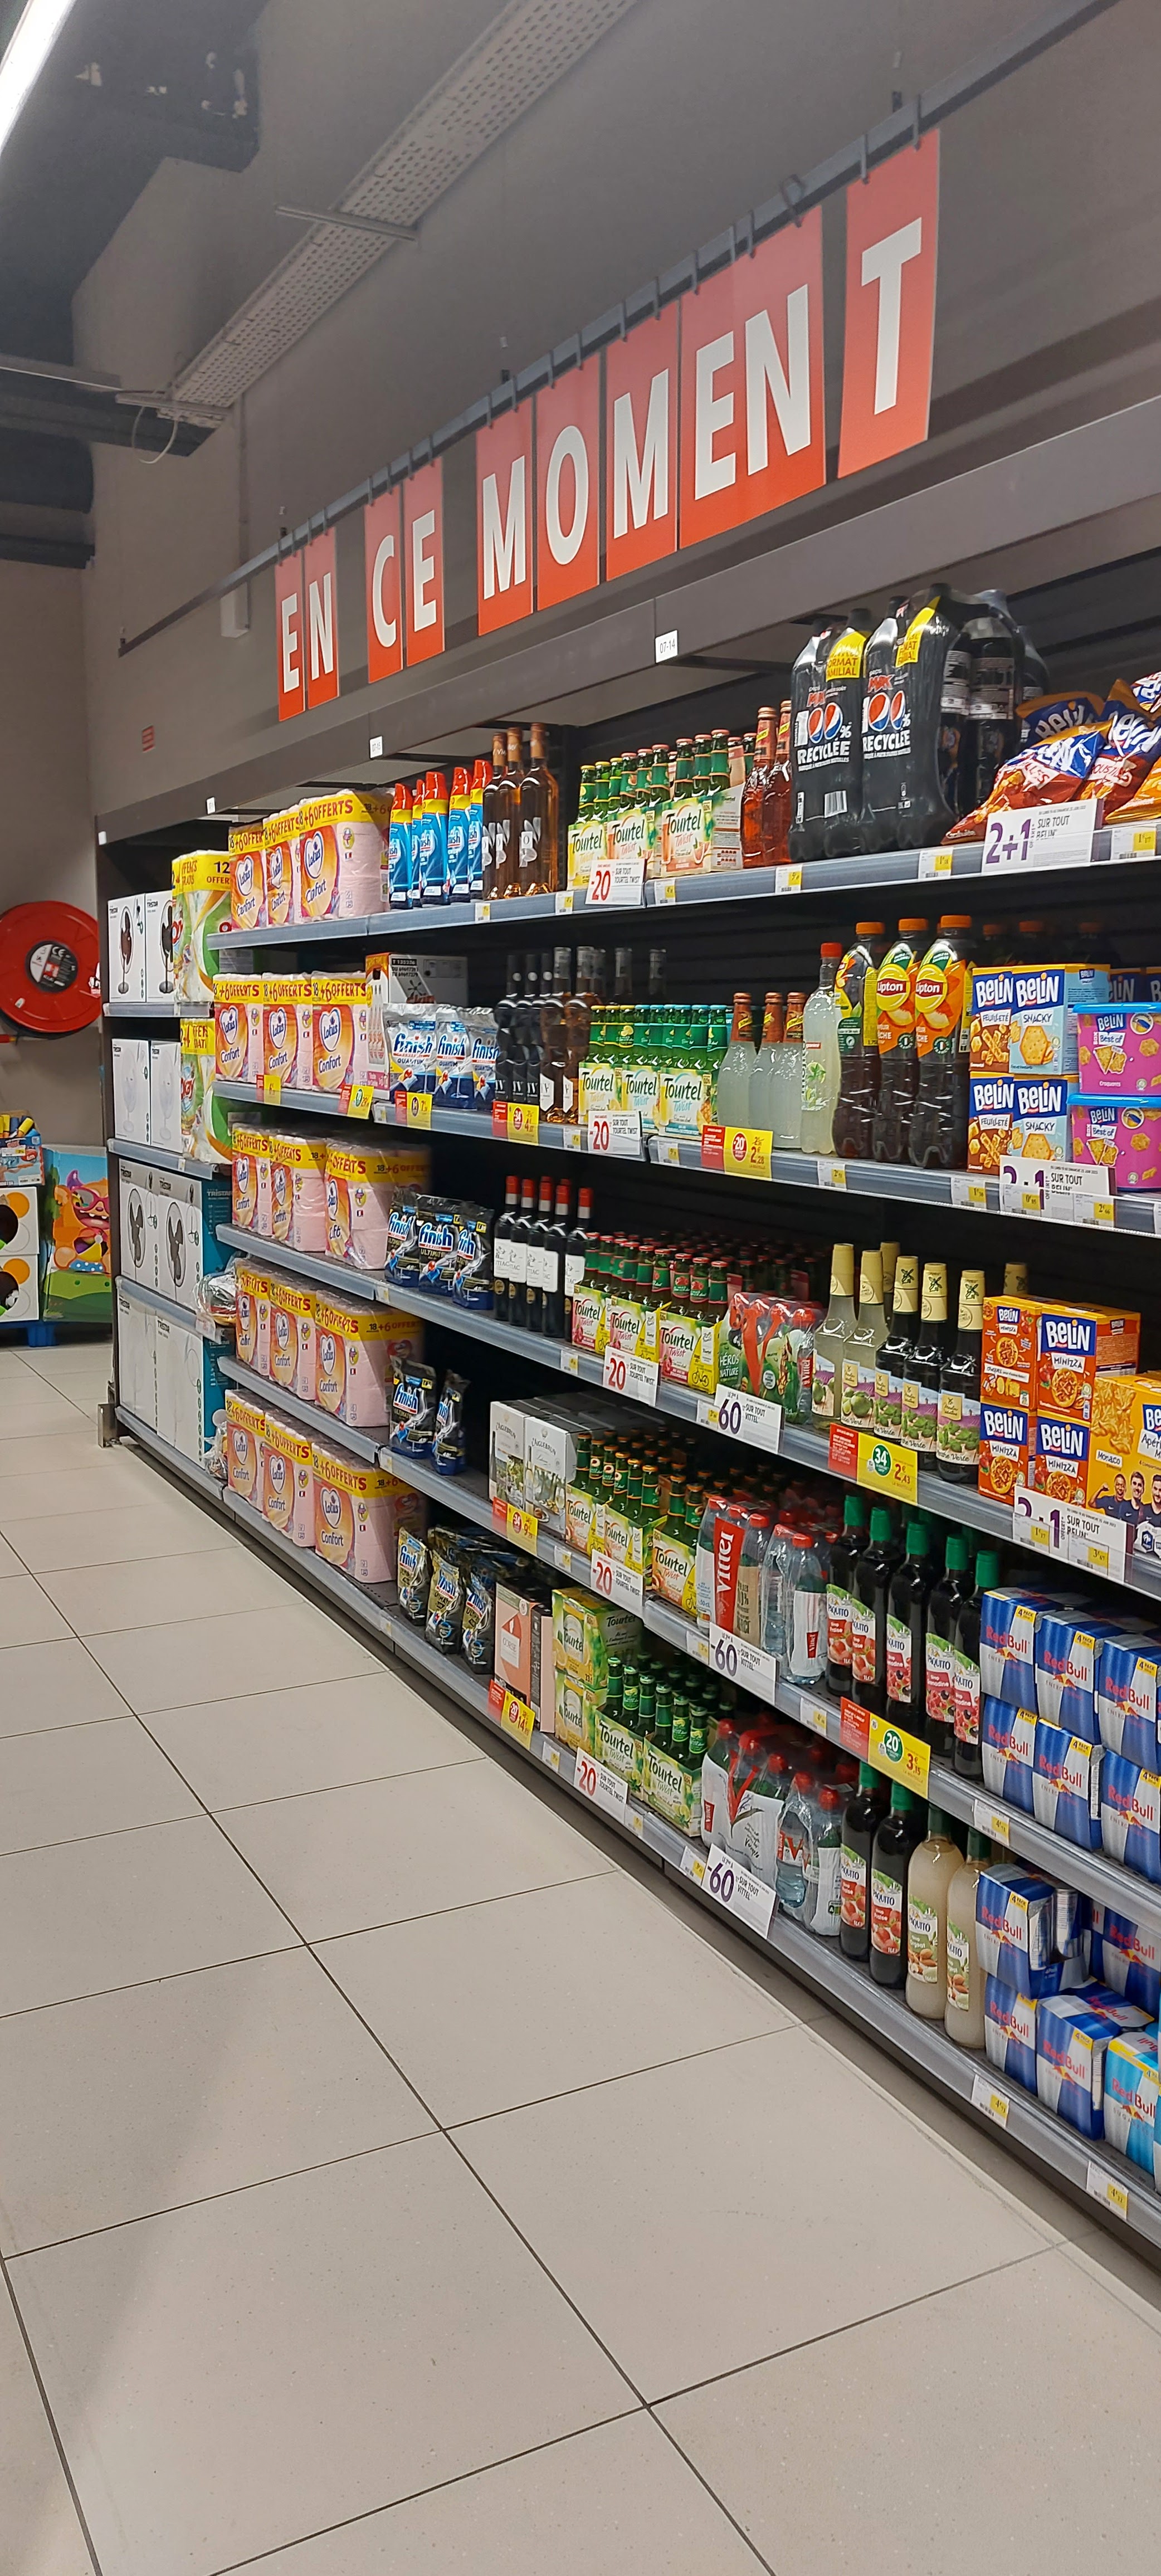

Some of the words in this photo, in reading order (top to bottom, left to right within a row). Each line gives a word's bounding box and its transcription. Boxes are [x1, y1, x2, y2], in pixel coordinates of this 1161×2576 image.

[281, 572, 333, 692] EN
[372, 509, 436, 648] CE
[482, 217, 922, 600] MOMENT
[660, 638, 675, 653] 07-14
[862, 728, 911, 753] RECYCLÉE
[797, 737, 851, 765] RECYCLÉE
[314, 799, 353, 822] OFFERTS
[612, 816, 645, 845] Tourtel
[667, 809, 703, 835] Tourtel
[1037, 817, 1051, 830] SUR
[1052, 815, 1070, 827] TOUT
[572, 829, 603, 853] Tourtel
[675, 831, 693, 846] Twist
[986, 819, 1032, 864] 2+1
[308, 847, 321, 867] Lotus
[214, 862, 230, 874] 12
[591, 870, 611, 901] -20
[230, 984, 260, 997] OFFERTS
[278, 984, 311, 997] OFFERTS
[313, 982, 319, 994] 18
[320, 983, 331, 1002] +6
[331, 982, 366, 997] OFFERTS
[877, 982, 904, 993] Lipton
[915, 983, 940, 994] Lipton
[975, 974, 1014, 1009] BELIN
[1016, 973, 1060, 1008] BELIN
[223, 1020, 235, 1033] Lotus
[1023, 1012, 1053, 1024] SNACKY
[1097, 1014, 1124, 1032] BELIN
[272, 1023, 284, 1037] Lotus
[324, 1024, 338, 1040] Lotus
[1100, 1033, 1114, 1043] Best
[1115, 1034, 1123, 1043] of
[393, 1032, 433, 1054] finish
[437, 1032, 465, 1056] finish
[472, 1038, 500, 1059] finish
[221, 1048, 240, 1063] Confort
[269, 1051, 288, 1070] Confort
[319, 1055, 342, 1074] Confort
[581, 1071, 613, 1092] Tourtel
[626, 1074, 656, 1096] Tourtel
[664, 1077, 702, 1100] Tourtel
[633, 1096, 649, 1107] Twist
[973, 1079, 1014, 1111] BELIN
[1017, 1082, 1062, 1114] BELIN
[673, 1100, 692, 1112] Twist
[1090, 1107, 1116, 1124] BELIN
[589, 1120, 609, 1150] -20
[1025, 1120, 1055, 1133] SNACKY
[1092, 1126, 1106, 1136] Best
[159, 1180, 172, 1191] TRISTAR
[1051, 1172, 1064, 1183] SUR
[1065, 1174, 1083, 1186] TOUT
[419, 1222, 452, 1247] finish
[574, 1299, 601, 1321] Tourtel
[998, 1307, 1018, 1324] BELIN
[157, 1320, 170, 1333] TRISTAR
[580, 1315, 593, 1326] Twist
[611, 1312, 640, 1335] Tourtel
[999, 1325, 1017, 1333] MINIZZA
[618, 1329, 632, 1341] Twist
[660, 1327, 694, 1350] Tourtel
[1045, 1319, 1090, 1353] BELIN
[275, 1354, 291, 1368] Confort
[669, 1346, 685, 1358] Twist
[720, 1354, 739, 1367] HÉROS
[1053, 1355, 1083, 1370] MINIZZA
[606, 1357, 626, 1391] -20
[719, 1367, 739, 1378] NATURE
[319, 1379, 338, 1393] Confort
[393, 1382, 418, 1413] finish
[745, 1403, 754, 1413] SUR
[754, 1407, 765, 1418] TOUT
[880, 1426, 895, 1436] Verte
[984, 1409, 1023, 1442] BELIN
[909, 1440, 926, 1450] Verte
[1040, 1423, 1084, 1458] BELIN
[951, 1453, 970, 1463] Verte
[992, 1444, 1018, 1458] MINIZZA
[1097, 1452, 1121, 1465] Monaco
[233, 1467, 250, 1481] Confort
[271, 1467, 284, 1481] Lotus
[320, 1460, 331, 1481] +6
[331, 1466, 367, 1491] OFFERTS
[1047, 1459, 1077, 1475] MINIZZA
[268, 1496, 286, 1511] Confort
[324, 1501, 339, 1516] Lotus
[1067, 1514, 1080, 1527] SUR
[1081, 1519, 1100, 1534] TOUT
[321, 1531, 344, 1546] Confort
[716, 1532, 734, 1594] Vittel
[592, 1560, 612, 1596] -20
[1024, 1611, 1034, 1619] PACK
[986, 1624, 1006, 1647] Red
[1007, 1635, 1028, 1655] Bull
[740, 1648, 749, 1660] SUR
[749, 1655, 760, 1666] TOUT
[1043, 1650, 1065, 1671] Red
[1066, 1660, 1089, 1682] Bull
[1105, 1676, 1128, 1699] Red
[1128, 1688, 1150, 1711] Bull
[599, 1721, 633, 1759] Tourtel
[988, 1724, 1008, 1745] Red
[1009, 1733, 1029, 1757] Bull
[609, 1750, 626, 1764] Twist
[577, 1760, 597, 1797] -20
[648, 1751, 683, 1792] Tourtel
[1039, 1753, 1061, 1778] Red
[1062, 1766, 1082, 1789] Bull
[1108, 1784, 1130, 1806] Red
[1131, 1797, 1154, 1821] Bull
[708, 1862, 734, 1903] -60
[738, 1876, 748, 1887] SUR
[747, 1882, 759, 1897] TOUT
[981, 1906, 1002, 1928] Red
[1002, 1916, 1022, 1941] Bull
